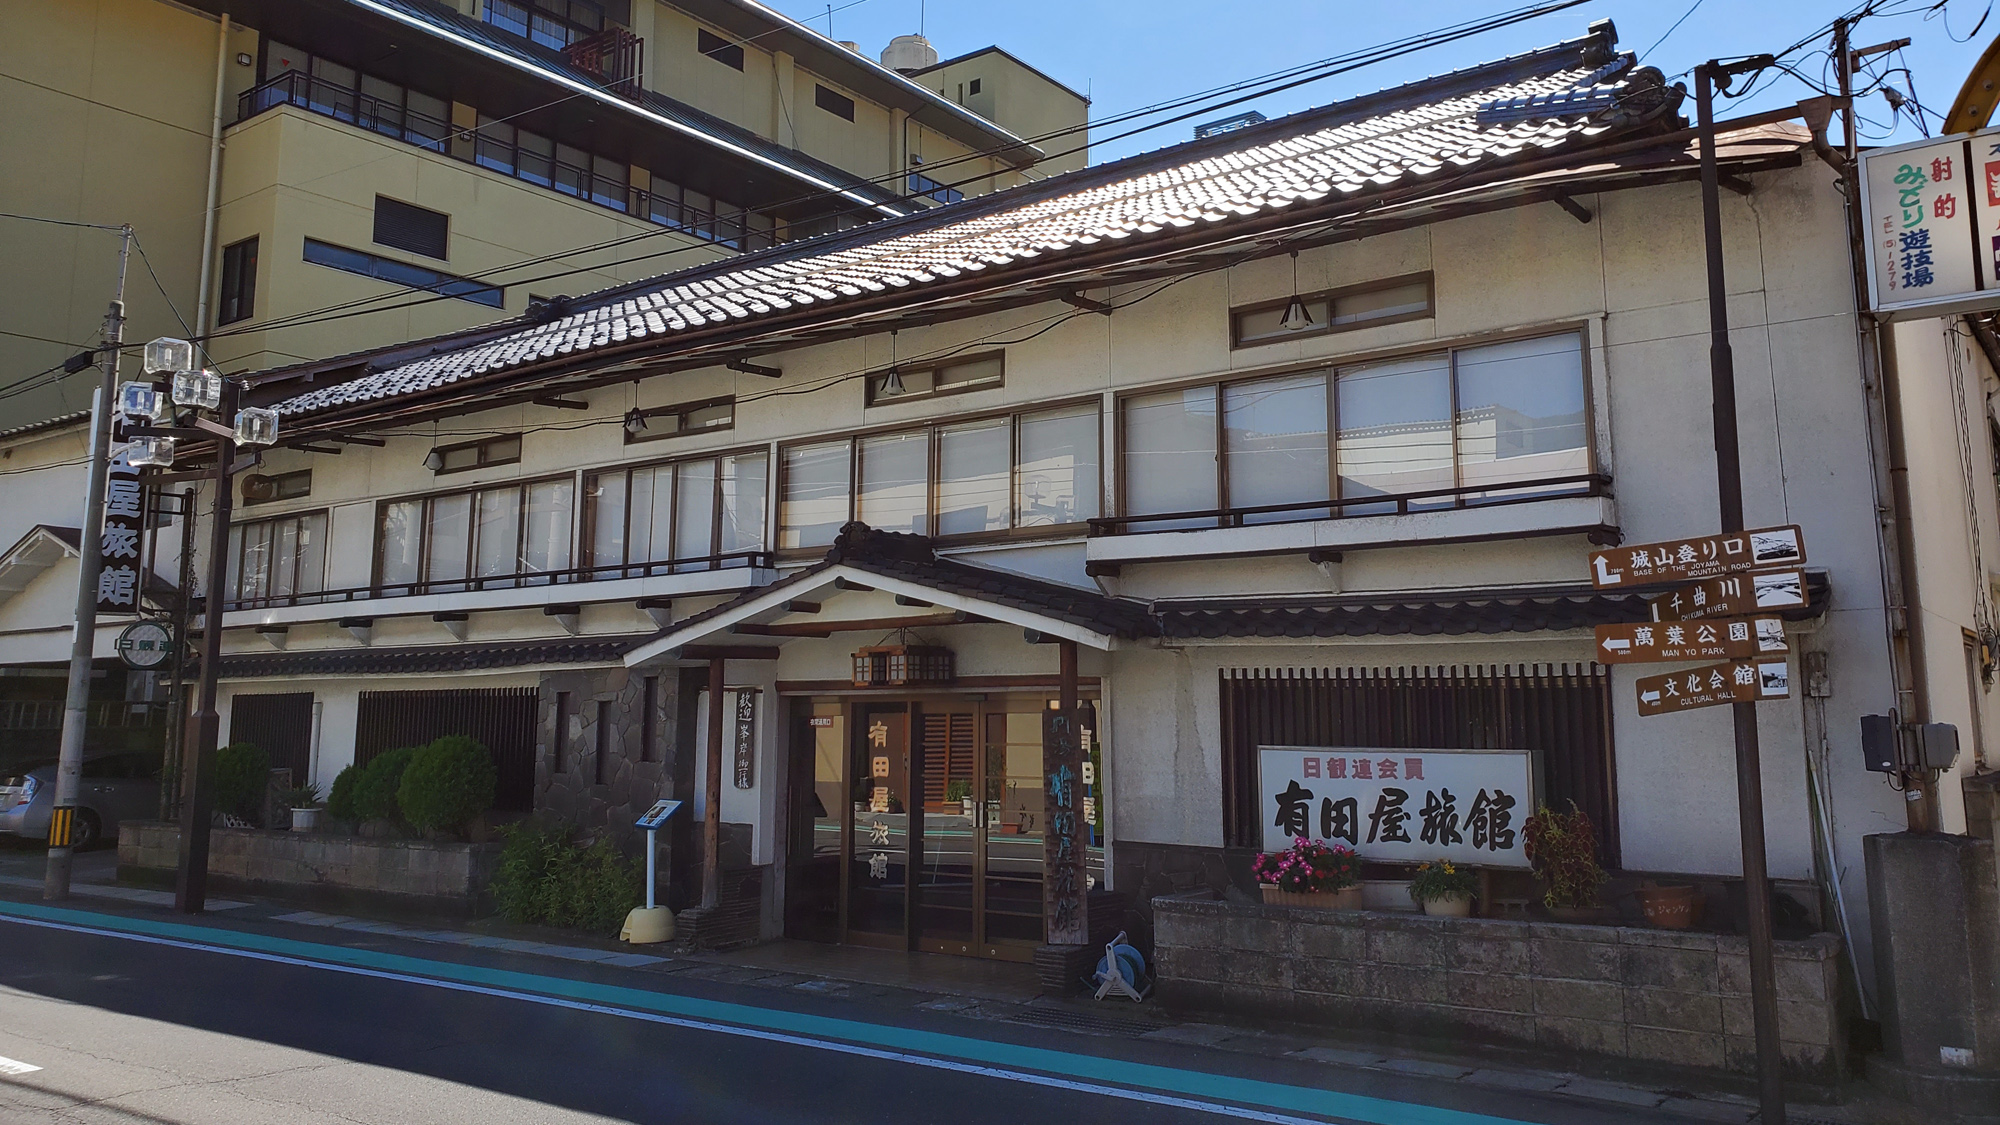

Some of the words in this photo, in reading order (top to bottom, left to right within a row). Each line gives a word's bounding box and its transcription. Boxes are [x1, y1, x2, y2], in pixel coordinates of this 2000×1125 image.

[1930, 155, 1957, 219] 射的
[1893, 163, 1934, 290] みどり遊技場
[1630, 538, 1744, 569] 城山登り口
[1633, 568, 1653, 577] BASE
[1657, 566, 1667, 574] OF
[1671, 564, 1686, 572] THE
[1691, 559, 1720, 570] JOYAMA
[1687, 565, 1727, 577] MOUNTAIN
[1730, 562, 1752, 570] ROAD
[1670, 577, 1741, 615] 千曲川
[1681, 609, 1704, 622] CHIKUMA
[1706, 602, 1729, 616] RIVER
[1634, 621, 1749, 647] 萬葉公園
[1662, 649, 1680, 657] MAN
[1685, 648, 1697, 656] YO
[1701, 647, 1725, 655] PARK
[1664, 664, 1756, 698] 文化会館
[1680, 695, 1714, 706] CULTURAL
[1717, 691, 1737, 700] HALL
[1303, 757, 1425, 781] 日観連会員
[868, 720, 890, 880] 有田屋旅館
[1274, 779, 1517, 852] 有田屋旅館
